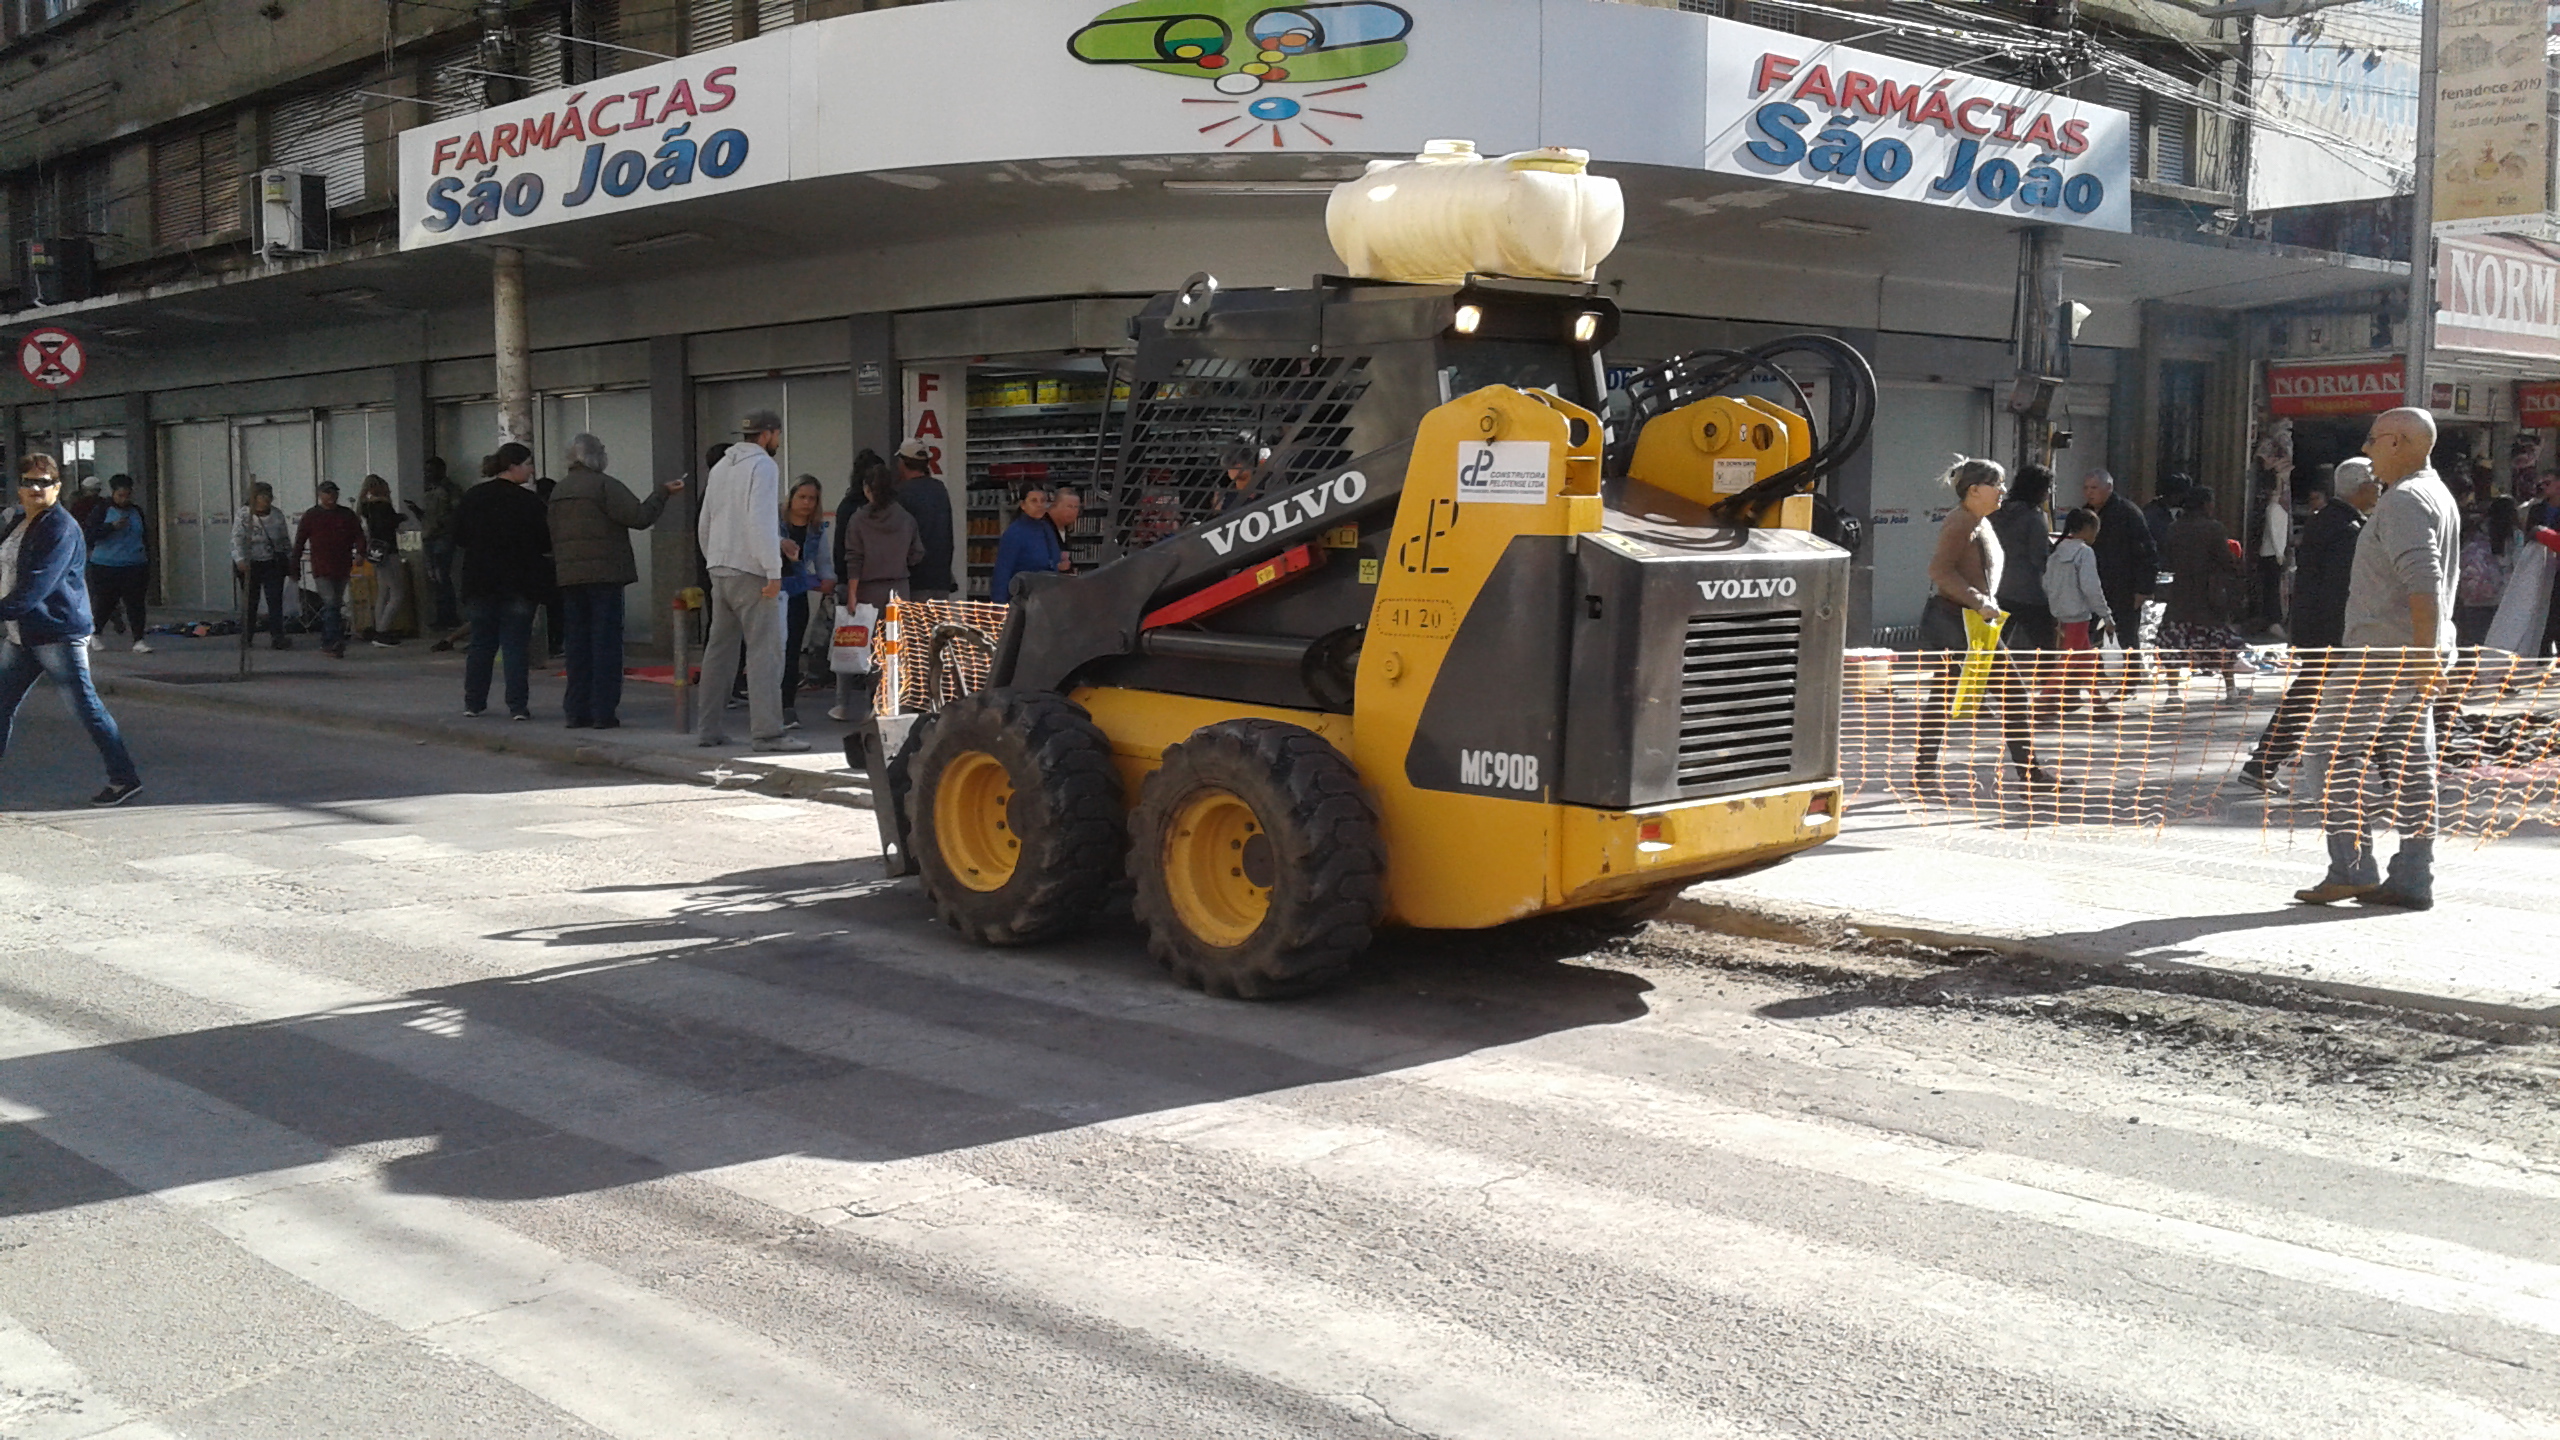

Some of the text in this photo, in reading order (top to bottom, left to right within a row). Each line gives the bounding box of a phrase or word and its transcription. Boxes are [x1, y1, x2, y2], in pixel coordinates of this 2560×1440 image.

[1757, 52, 2091, 155] FARMÁCIAS
[2441, 78, 2542, 101] fenadoce 2019
[431, 66, 738, 176] FARMÁCIAS
[421, 121, 750, 233] São João
[1745, 102, 2104, 215] São João
[2451, 249, 2560, 326] NORM
[2274, 372, 2402, 396] NORMAN
[1489, 471, 1545, 479] CONSTRUTORA
[1489, 479, 1526, 488] PELOTENSE
[1201, 470, 1367, 556] VOLVO
[1696, 577, 1797, 601] VOLVO
[1419, 608, 1442, 629] 20
[1460, 748, 1539, 791] MC90B
